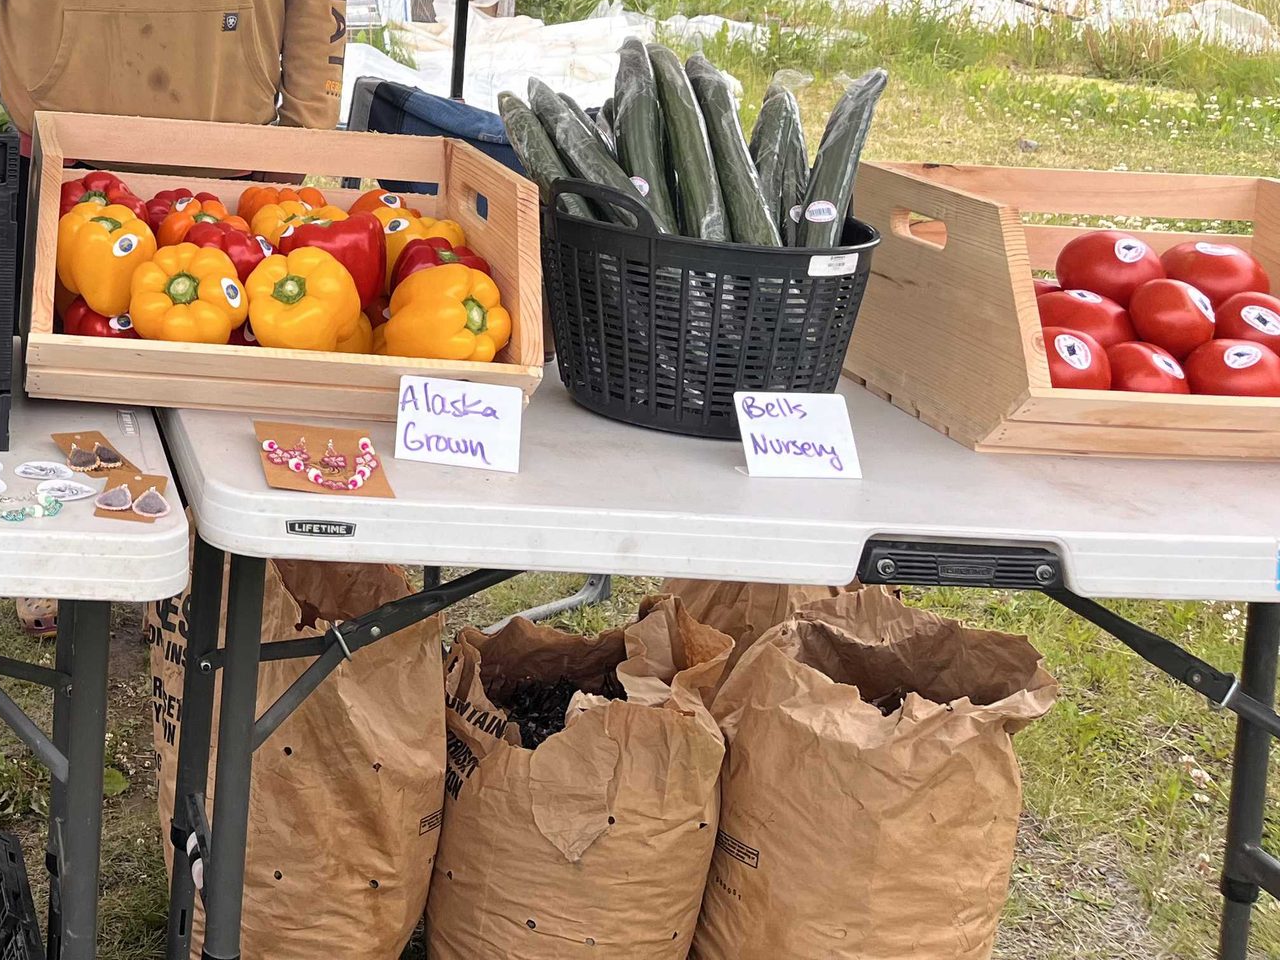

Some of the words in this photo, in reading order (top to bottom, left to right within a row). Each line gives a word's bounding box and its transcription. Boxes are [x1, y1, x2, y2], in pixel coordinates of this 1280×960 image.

[399, 382, 500, 420] Alaska
[742, 396, 807, 420] Bells
[403, 421, 491, 465] Grown
[750, 432, 843, 472] Nursery
[294, 523, 347, 534] LIFETIME
